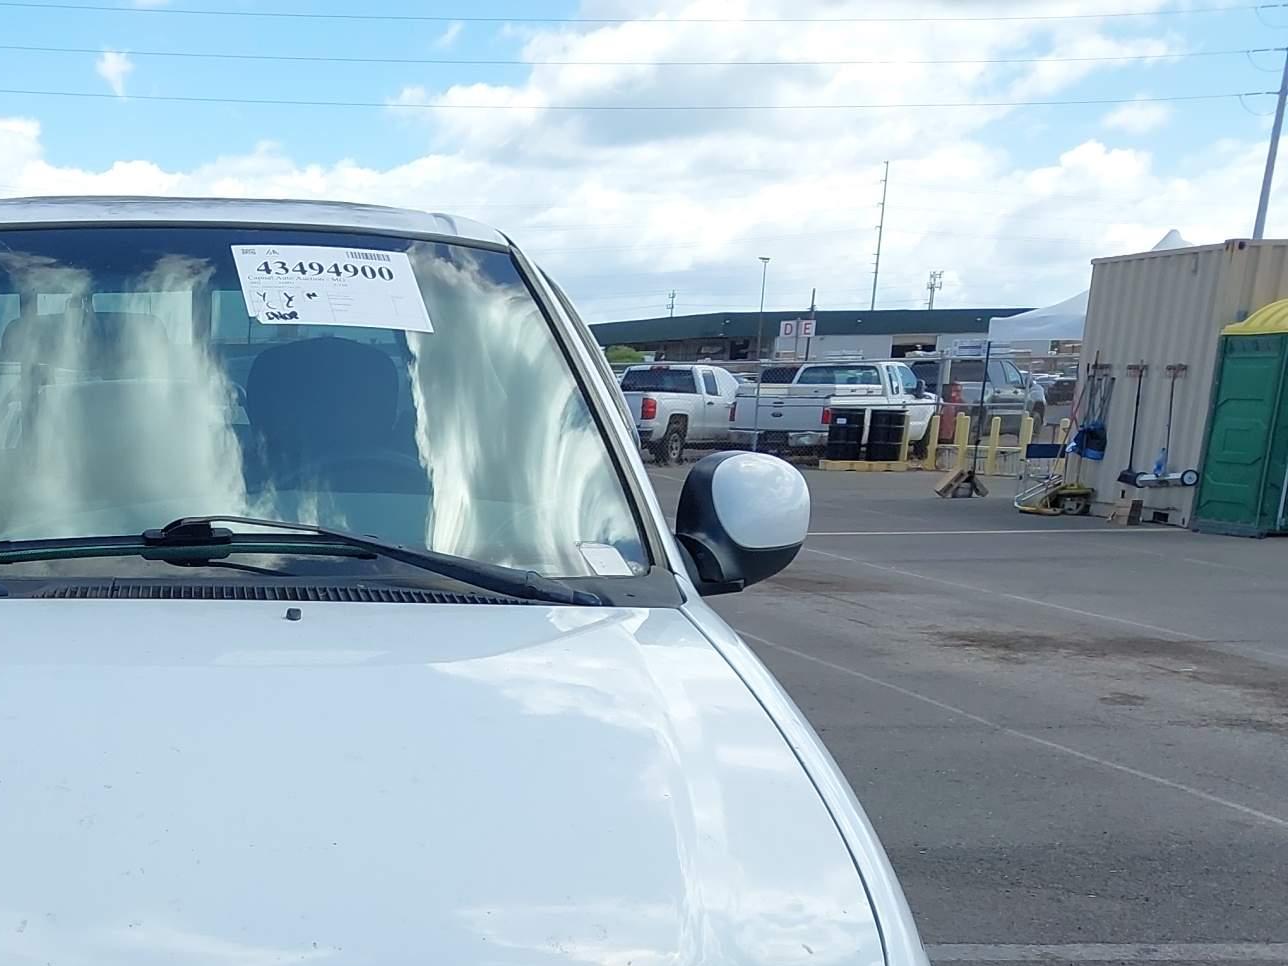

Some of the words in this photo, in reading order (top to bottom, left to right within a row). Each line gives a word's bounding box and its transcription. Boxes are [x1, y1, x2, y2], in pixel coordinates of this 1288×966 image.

[256, 260, 394, 282] 43494900
[784, 322, 793, 336] D
[803, 322, 813, 336] E
